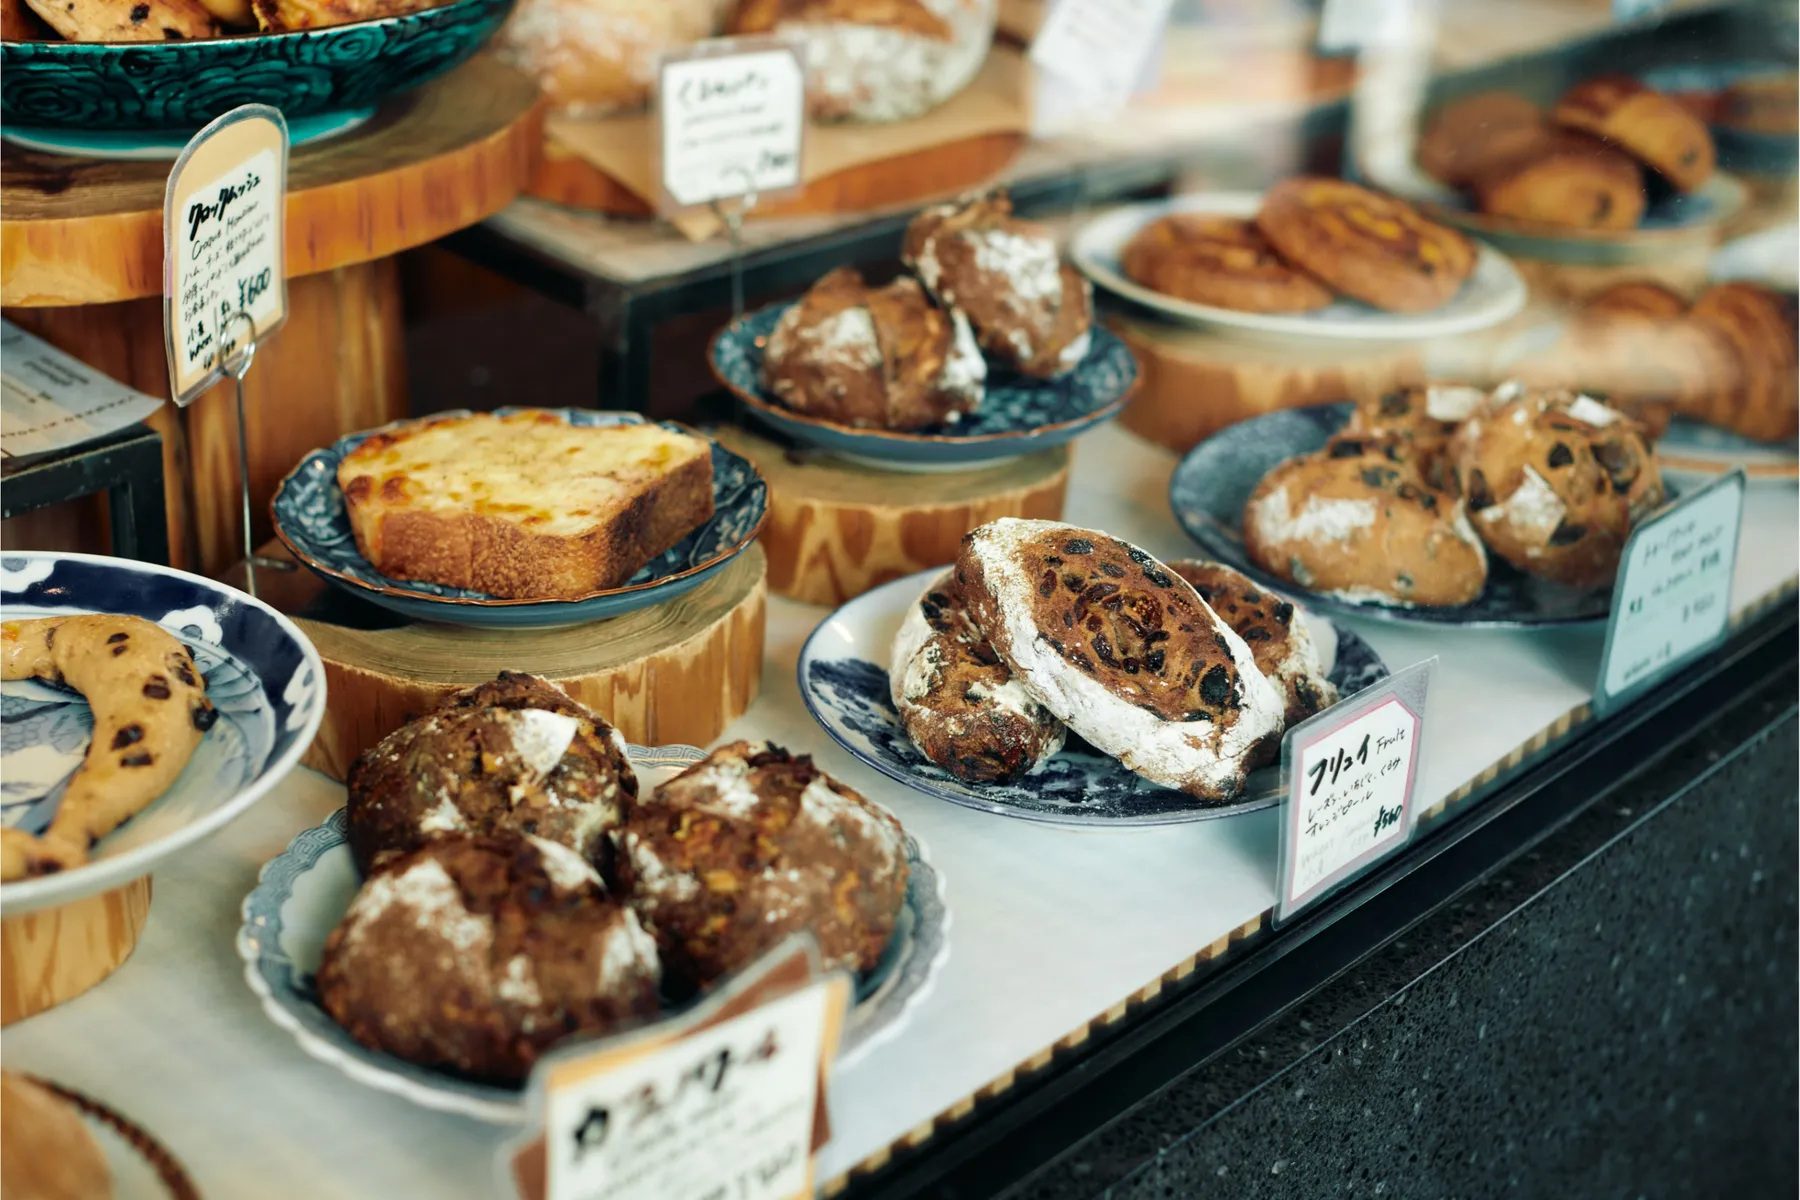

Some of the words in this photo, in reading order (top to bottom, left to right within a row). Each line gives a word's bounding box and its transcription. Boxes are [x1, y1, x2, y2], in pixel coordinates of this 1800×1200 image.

[189, 172, 260, 241] クロックムッシュ
[238, 266, 270, 313] ¥600
[1308, 733, 1371, 796] フリュイ
[1376, 727, 1405, 755] Fruit
[1305, 791, 1374, 837] オレンジピール
[1374, 804, 1403, 838] ¥560
